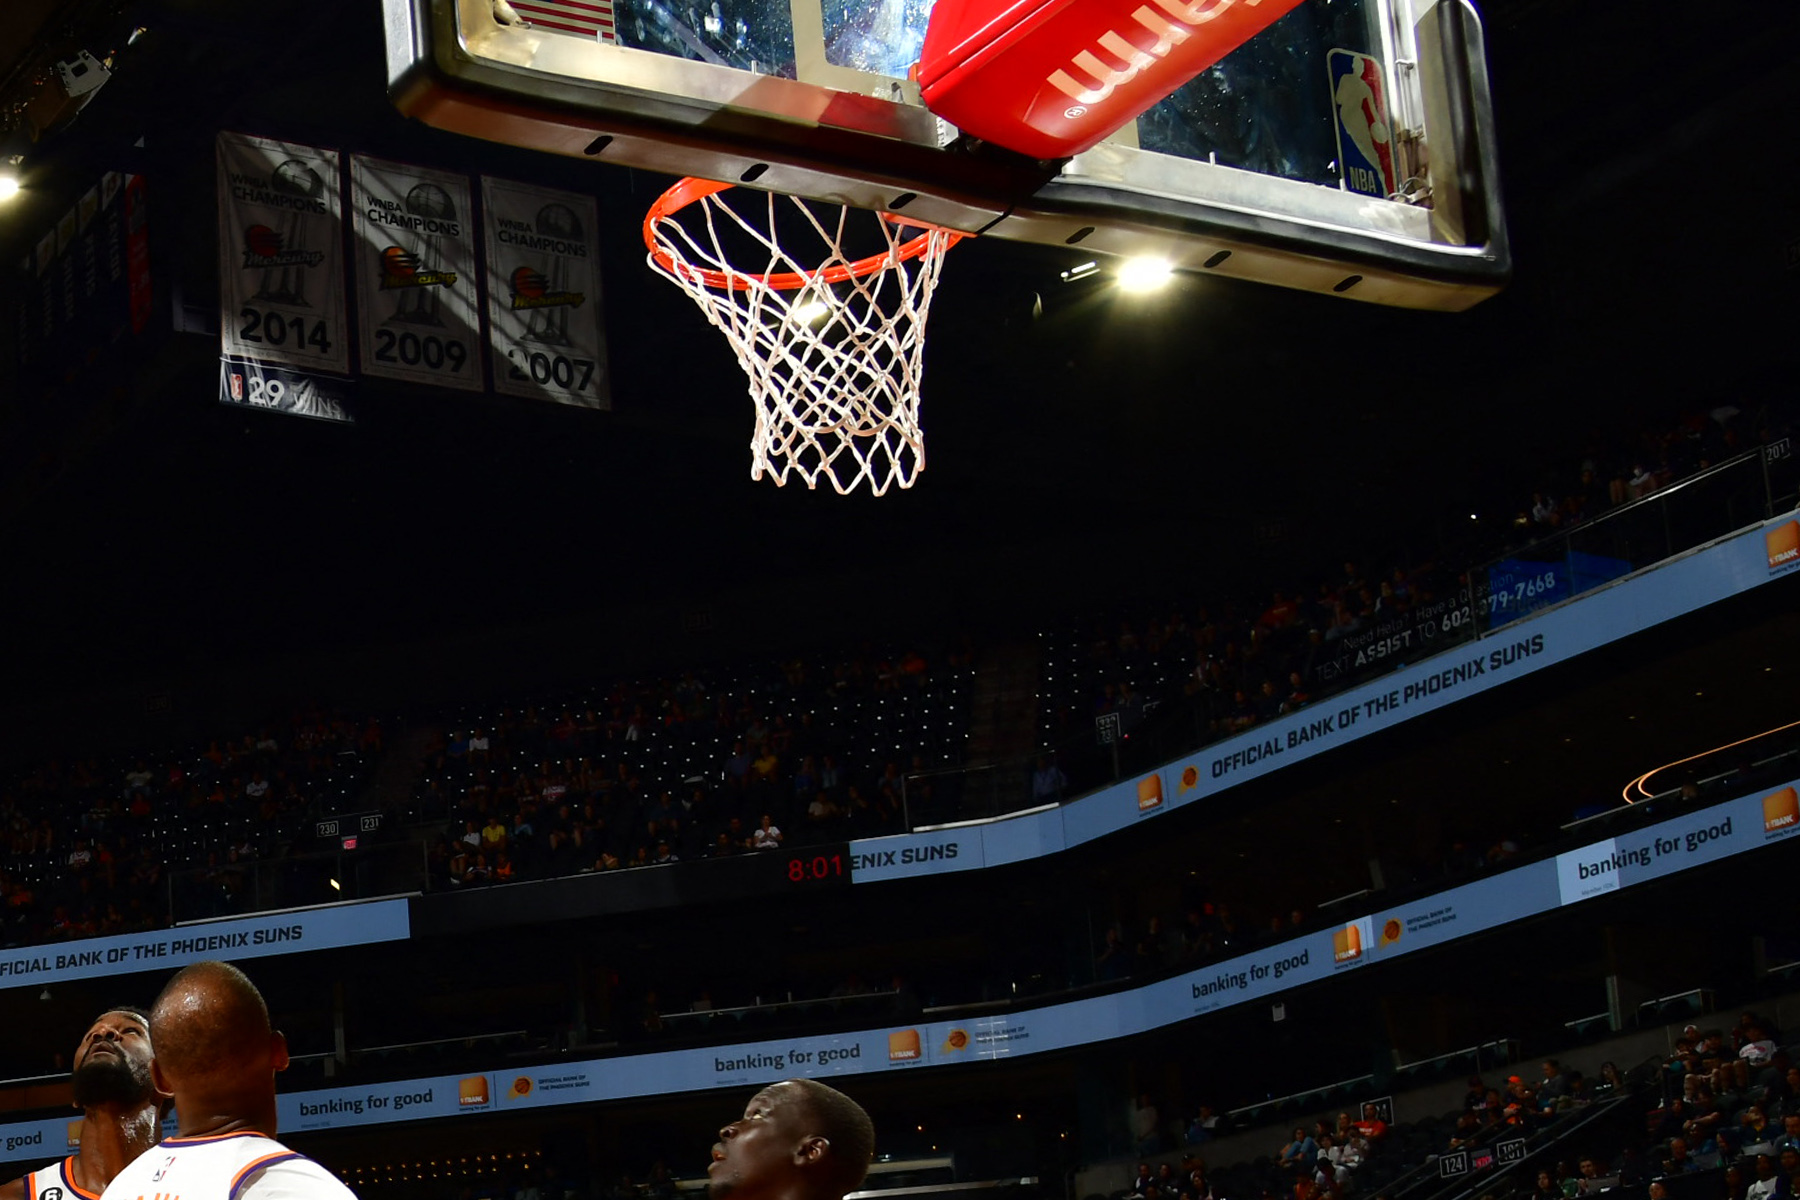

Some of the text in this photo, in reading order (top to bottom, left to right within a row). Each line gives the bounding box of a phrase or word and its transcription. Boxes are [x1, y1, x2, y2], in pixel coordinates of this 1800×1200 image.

[1349, 166, 1377, 193] NBA
[231, 186, 327, 215] CHAMPIONS
[367, 196, 402, 213] WNBA
[367, 209, 460, 237] CHAMPIONS
[498, 217, 533, 233] WNBA
[498, 230, 587, 257] CHAMPIONS
[239, 308, 331, 354] 2014
[375, 329, 467, 373] 2009
[509, 348, 594, 391] 2007
[248, 377, 285, 407] 29
[1316, 655, 1351, 681] TEXT
[1354, 630, 1413, 667] ASSIST
[1416, 621, 1437, 642] TO
[1212, 634, 1544, 778] OFFICIAL BANK OF THE PHOENIX SUNS
[901, 843, 958, 864] SUNS
[1579, 846, 1651, 881] banking
[1654, 835, 1680, 858] for
[1686, 817, 1732, 852] good
[788, 854, 843, 883] 8:01
[55, 951, 104, 969] BANK
[107, 947, 129, 963] OF
[133, 943, 167, 959] THE
[172, 932, 249, 955] PHOENIX
[253, 926, 303, 945] SUNS
[1192, 973, 1248, 999] banking
[1250, 965, 1270, 981] for
[1274, 949, 1309, 978] good
[715, 1043, 860, 1072] banking for good
[300, 1089, 433, 1117] banking for good
[6, 1131, 42, 1151] good
[1443, 1155, 1463, 1173] 124
